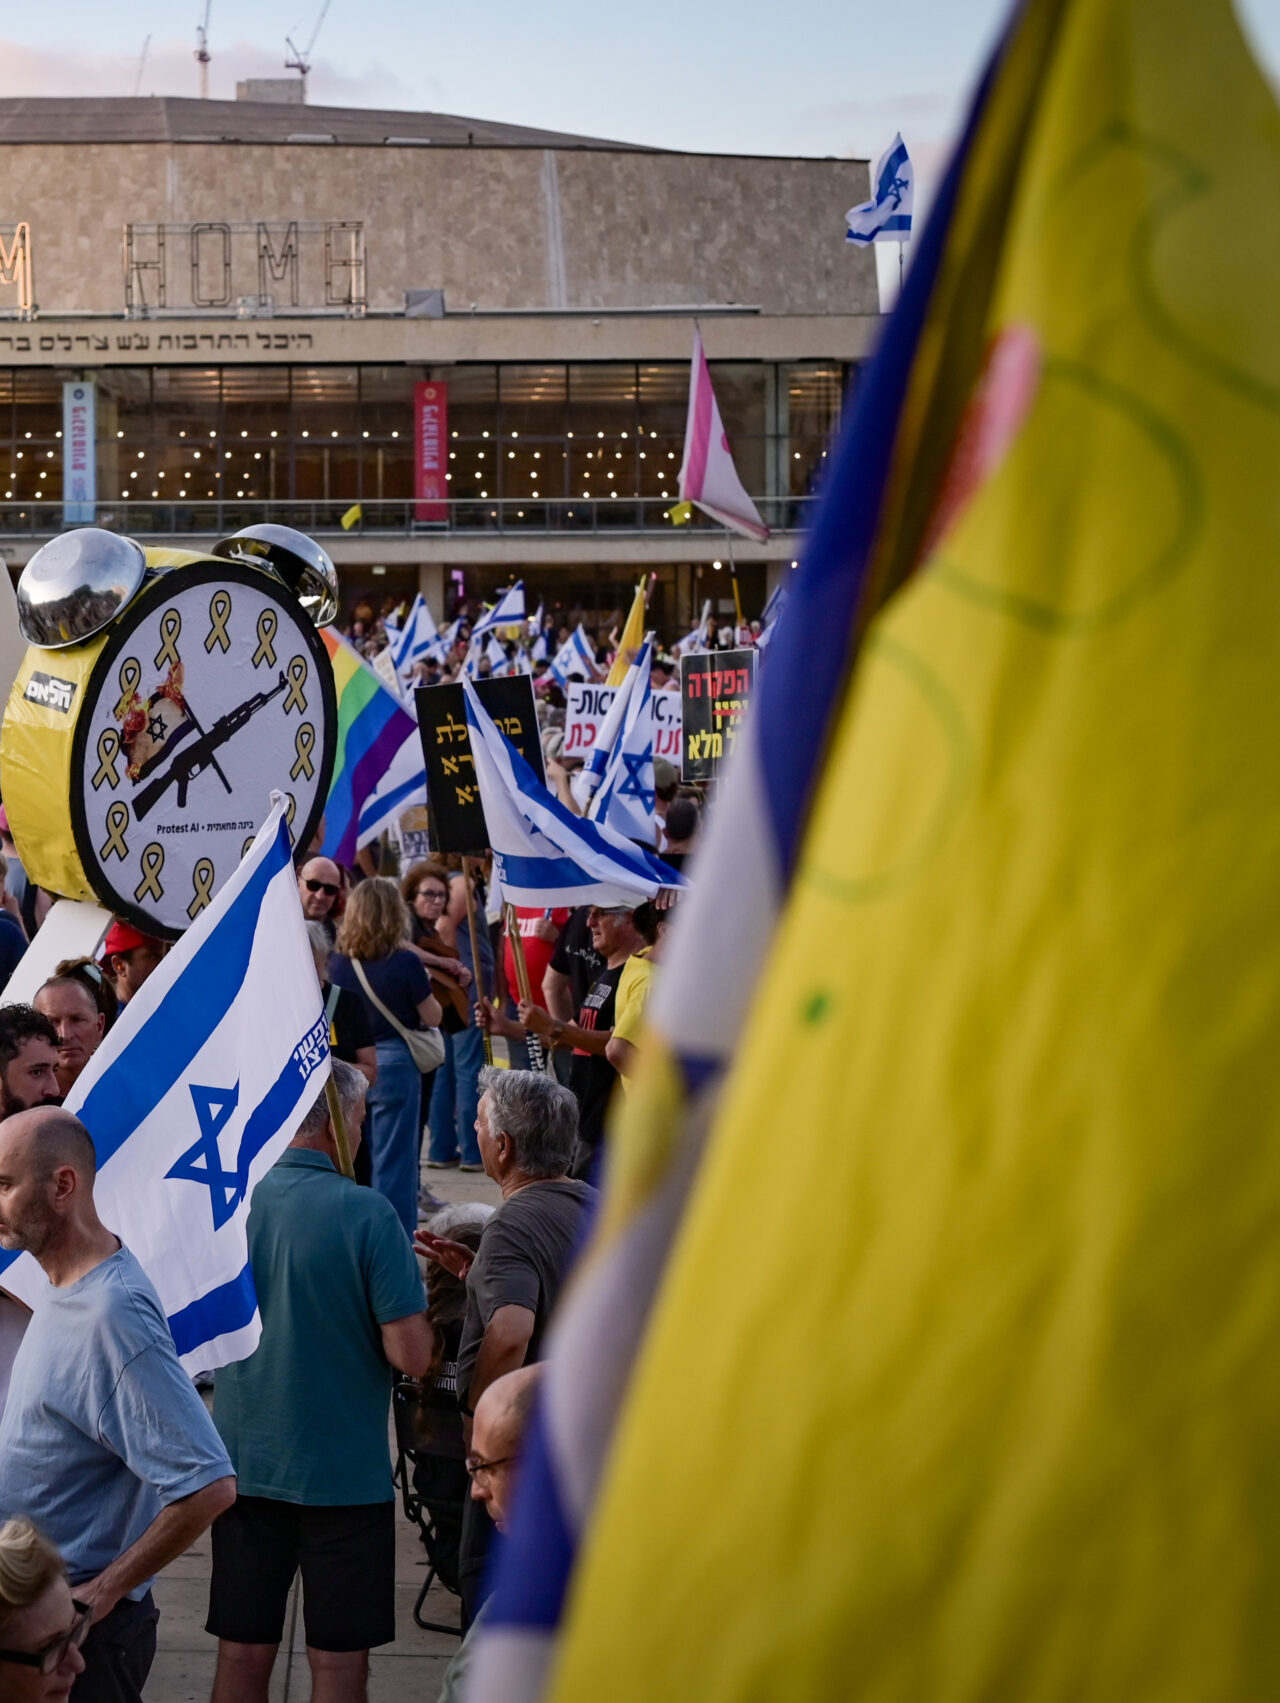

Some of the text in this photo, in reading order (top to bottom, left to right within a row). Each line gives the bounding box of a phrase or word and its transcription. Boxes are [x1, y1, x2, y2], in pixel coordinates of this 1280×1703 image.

[123, 221, 364, 308] HOME
[157, 334, 249, 350] התרבות
[256, 331, 313, 350] היכל
[688, 668, 750, 699] הפקרה
[157, 823, 189, 834] Protest
